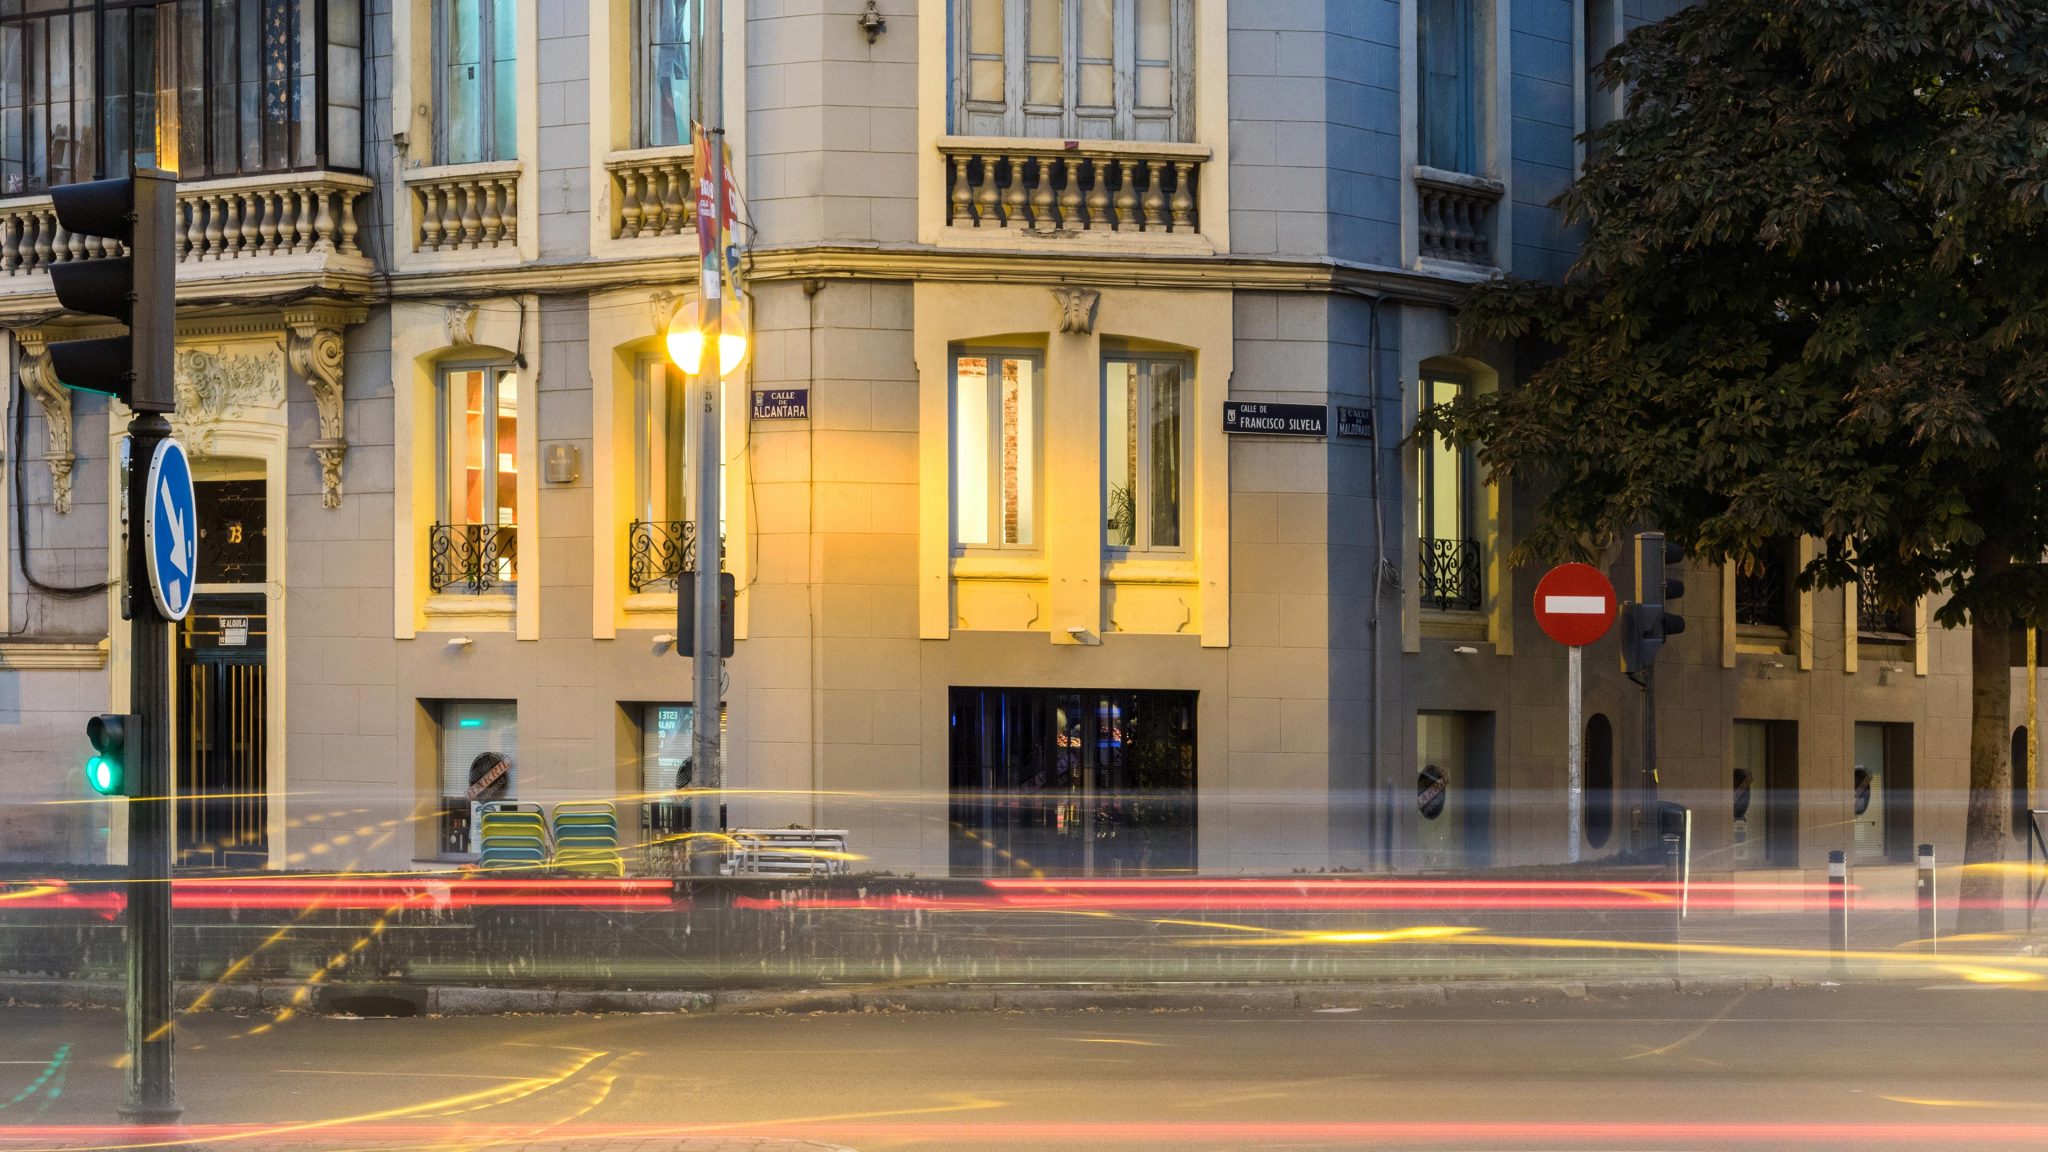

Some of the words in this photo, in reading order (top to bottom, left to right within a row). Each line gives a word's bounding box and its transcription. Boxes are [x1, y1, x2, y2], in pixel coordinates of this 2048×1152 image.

[771, 391, 795, 399] CALLE
[753, 405, 806, 418] ALCANTARA
[1240, 404, 1257, 413] CALLE
[1259, 405, 1268, 414] DE
[1240, 416, 1285, 430] FRANCISCO
[1289, 418, 1321, 431] SILVELA
